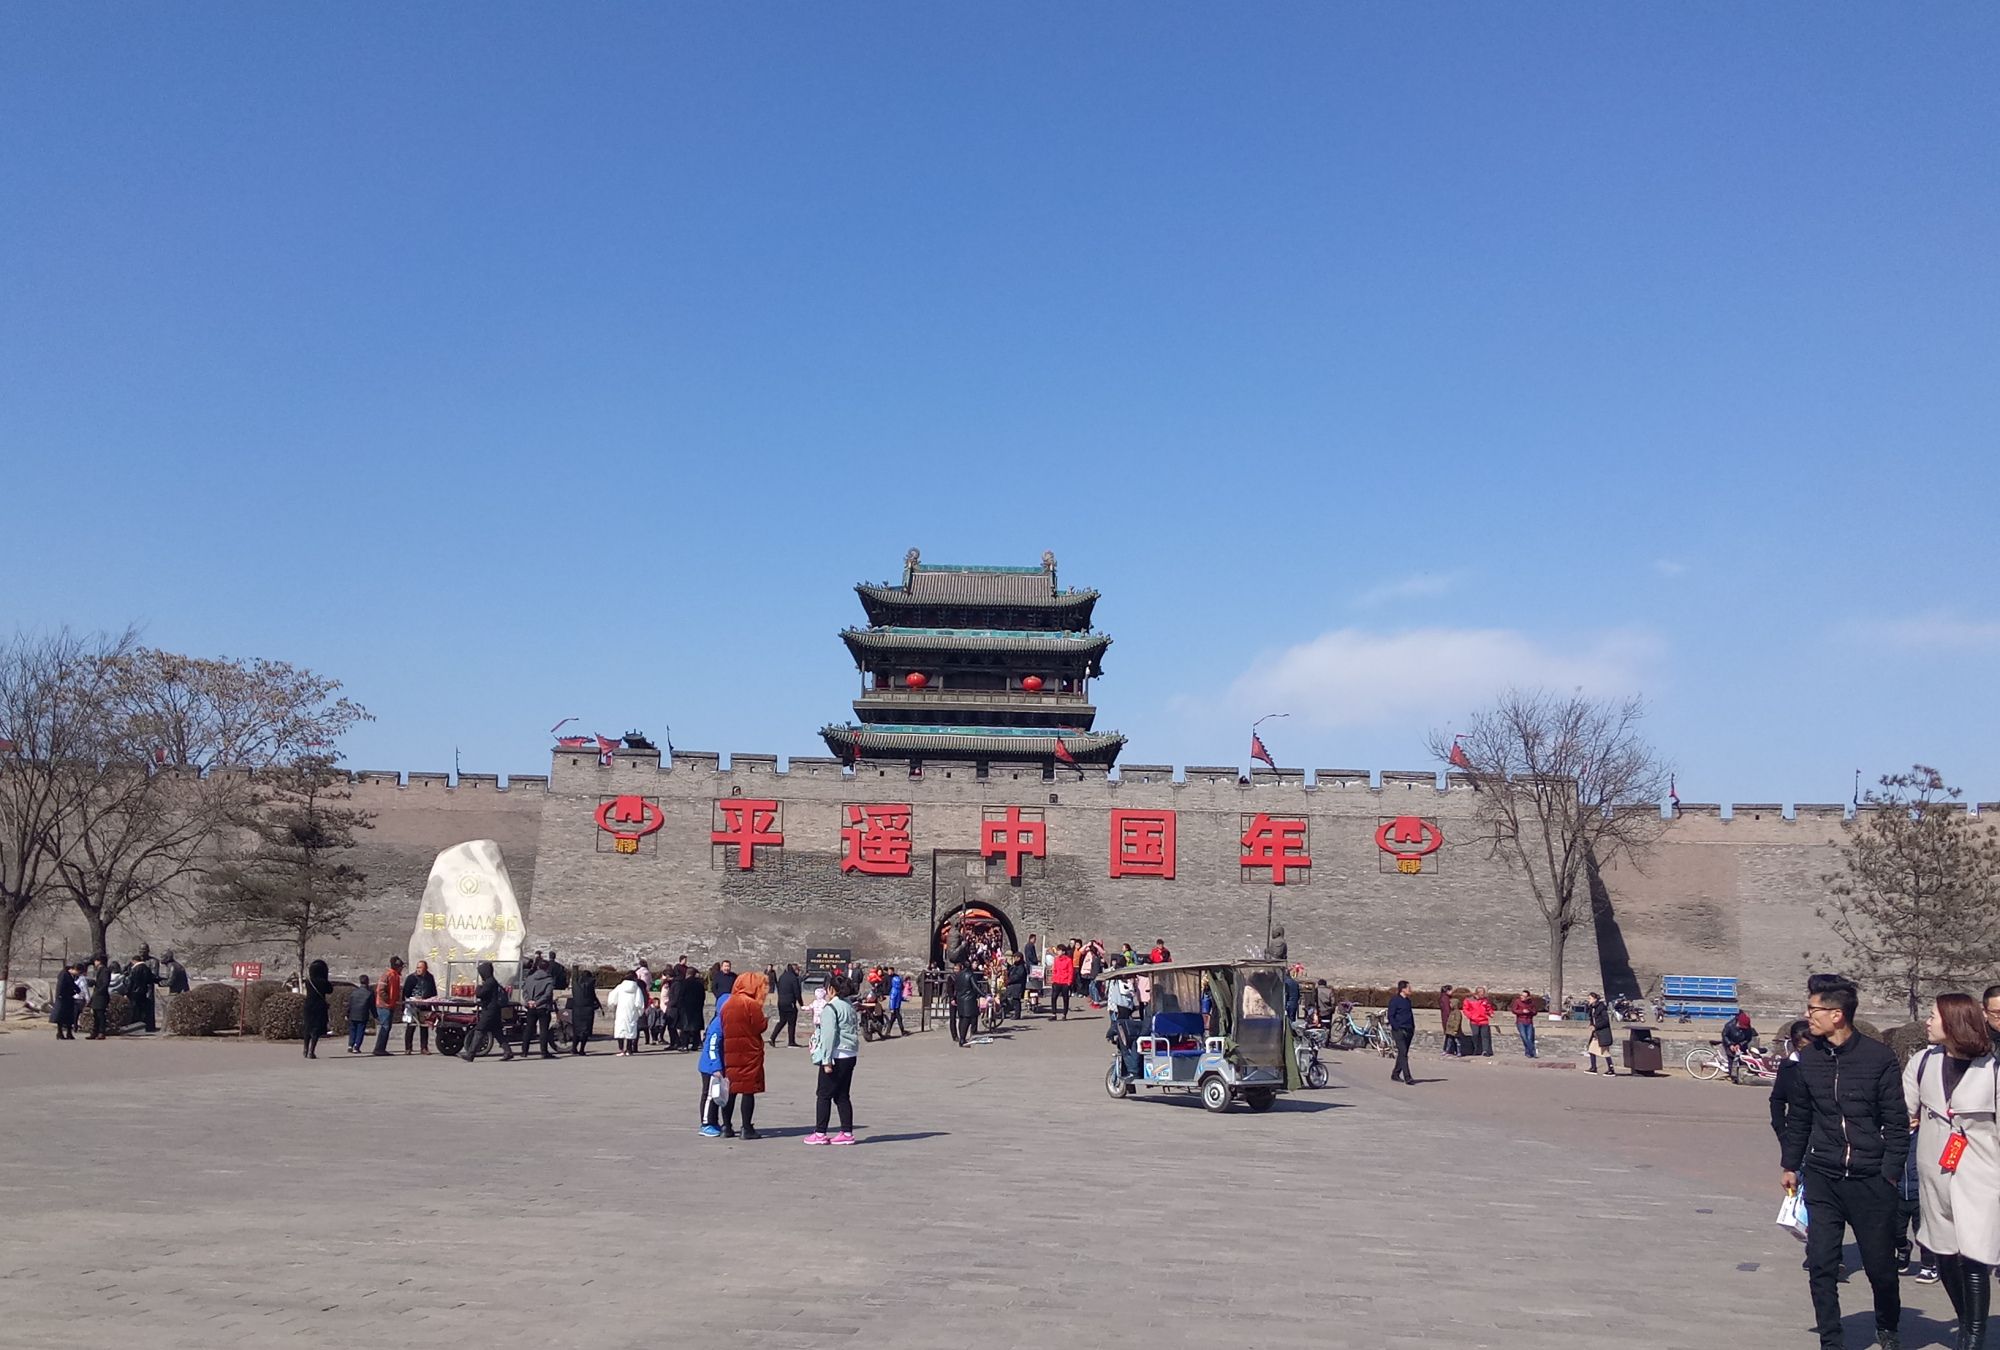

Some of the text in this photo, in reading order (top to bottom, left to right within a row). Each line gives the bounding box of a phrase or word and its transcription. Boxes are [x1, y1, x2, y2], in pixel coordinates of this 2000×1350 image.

[710, 799, 1312, 886] 平遥中国年
